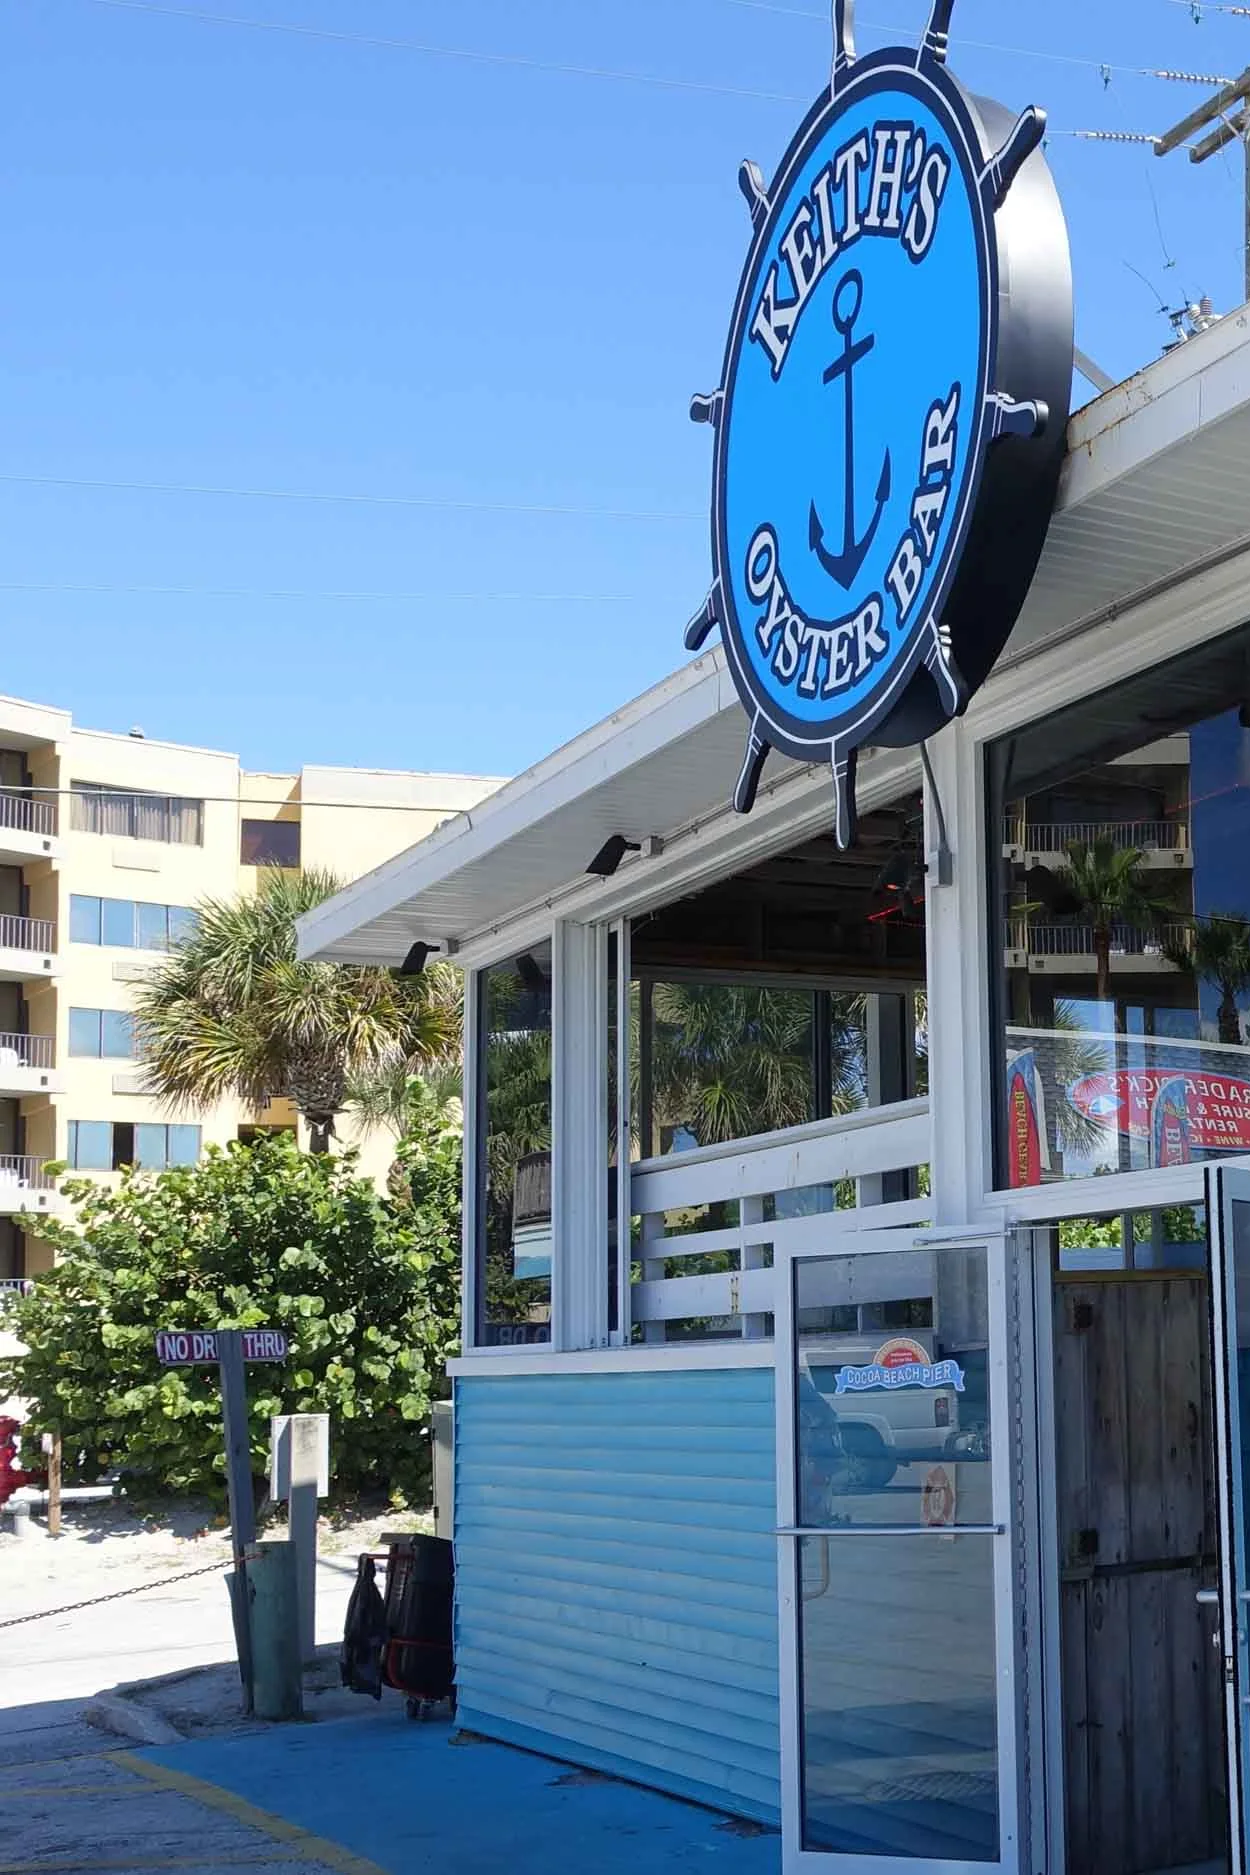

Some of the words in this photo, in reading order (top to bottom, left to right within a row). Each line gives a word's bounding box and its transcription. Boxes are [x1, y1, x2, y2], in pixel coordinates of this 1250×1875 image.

[752, 127, 949, 374] KEITH'S
[747, 528, 888, 694] OYSTER
[887, 389, 960, 613] BAR
[164, 1335, 189, 1360] NO
[244, 1333, 285, 1357] THRU
[847, 1369, 880, 1385] COCOA
[883, 1366, 920, 1384] BEACH
[922, 1363, 951, 1382] PIER
